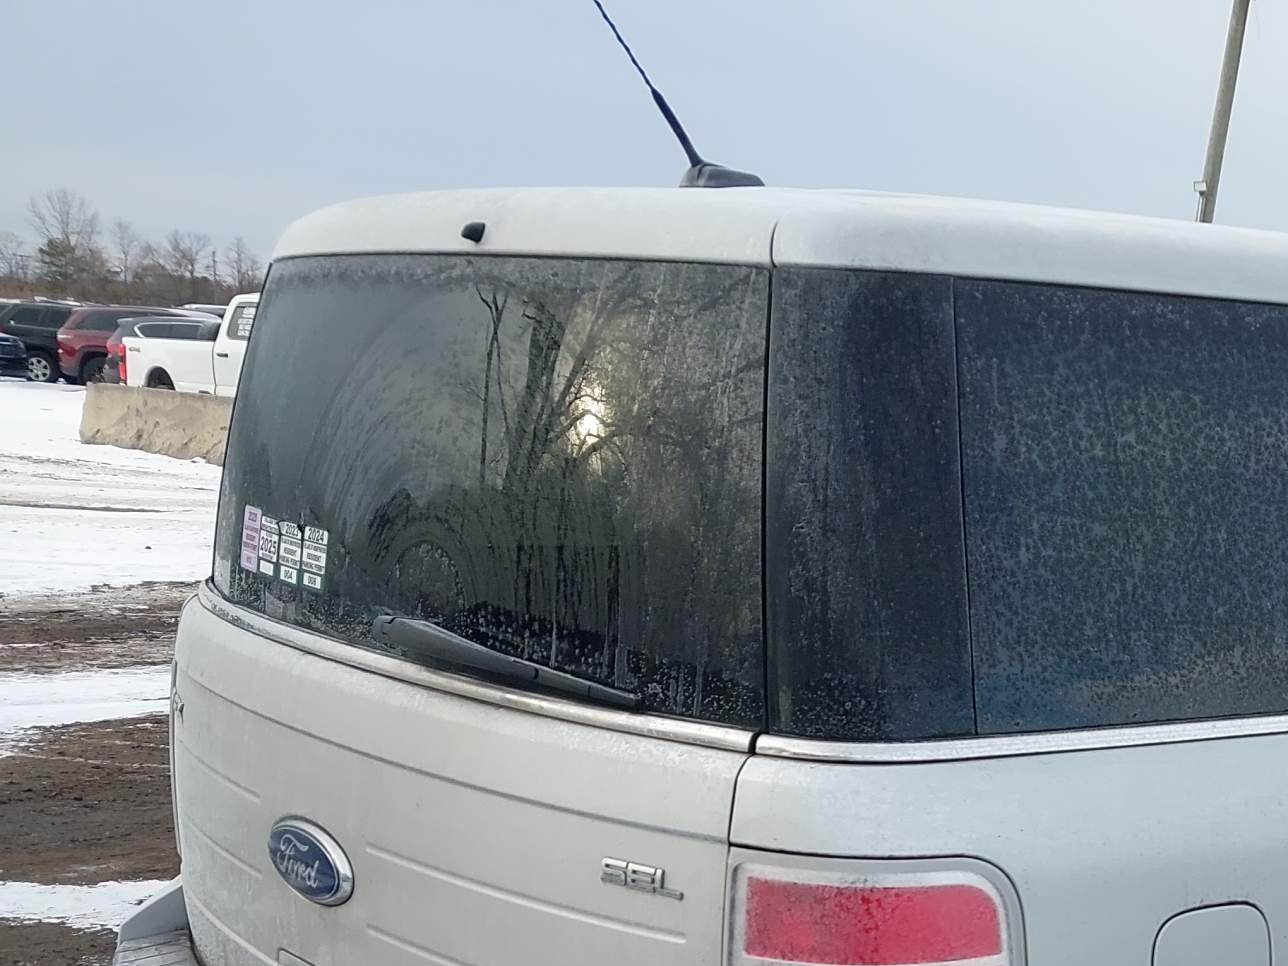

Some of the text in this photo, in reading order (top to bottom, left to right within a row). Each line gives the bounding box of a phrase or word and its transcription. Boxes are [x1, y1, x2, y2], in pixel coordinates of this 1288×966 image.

[260, 536, 277, 555] 2025
[308, 527, 324, 542] 2024
[277, 833, 319, 888] Ford
[600, 856, 684, 901] SEL
